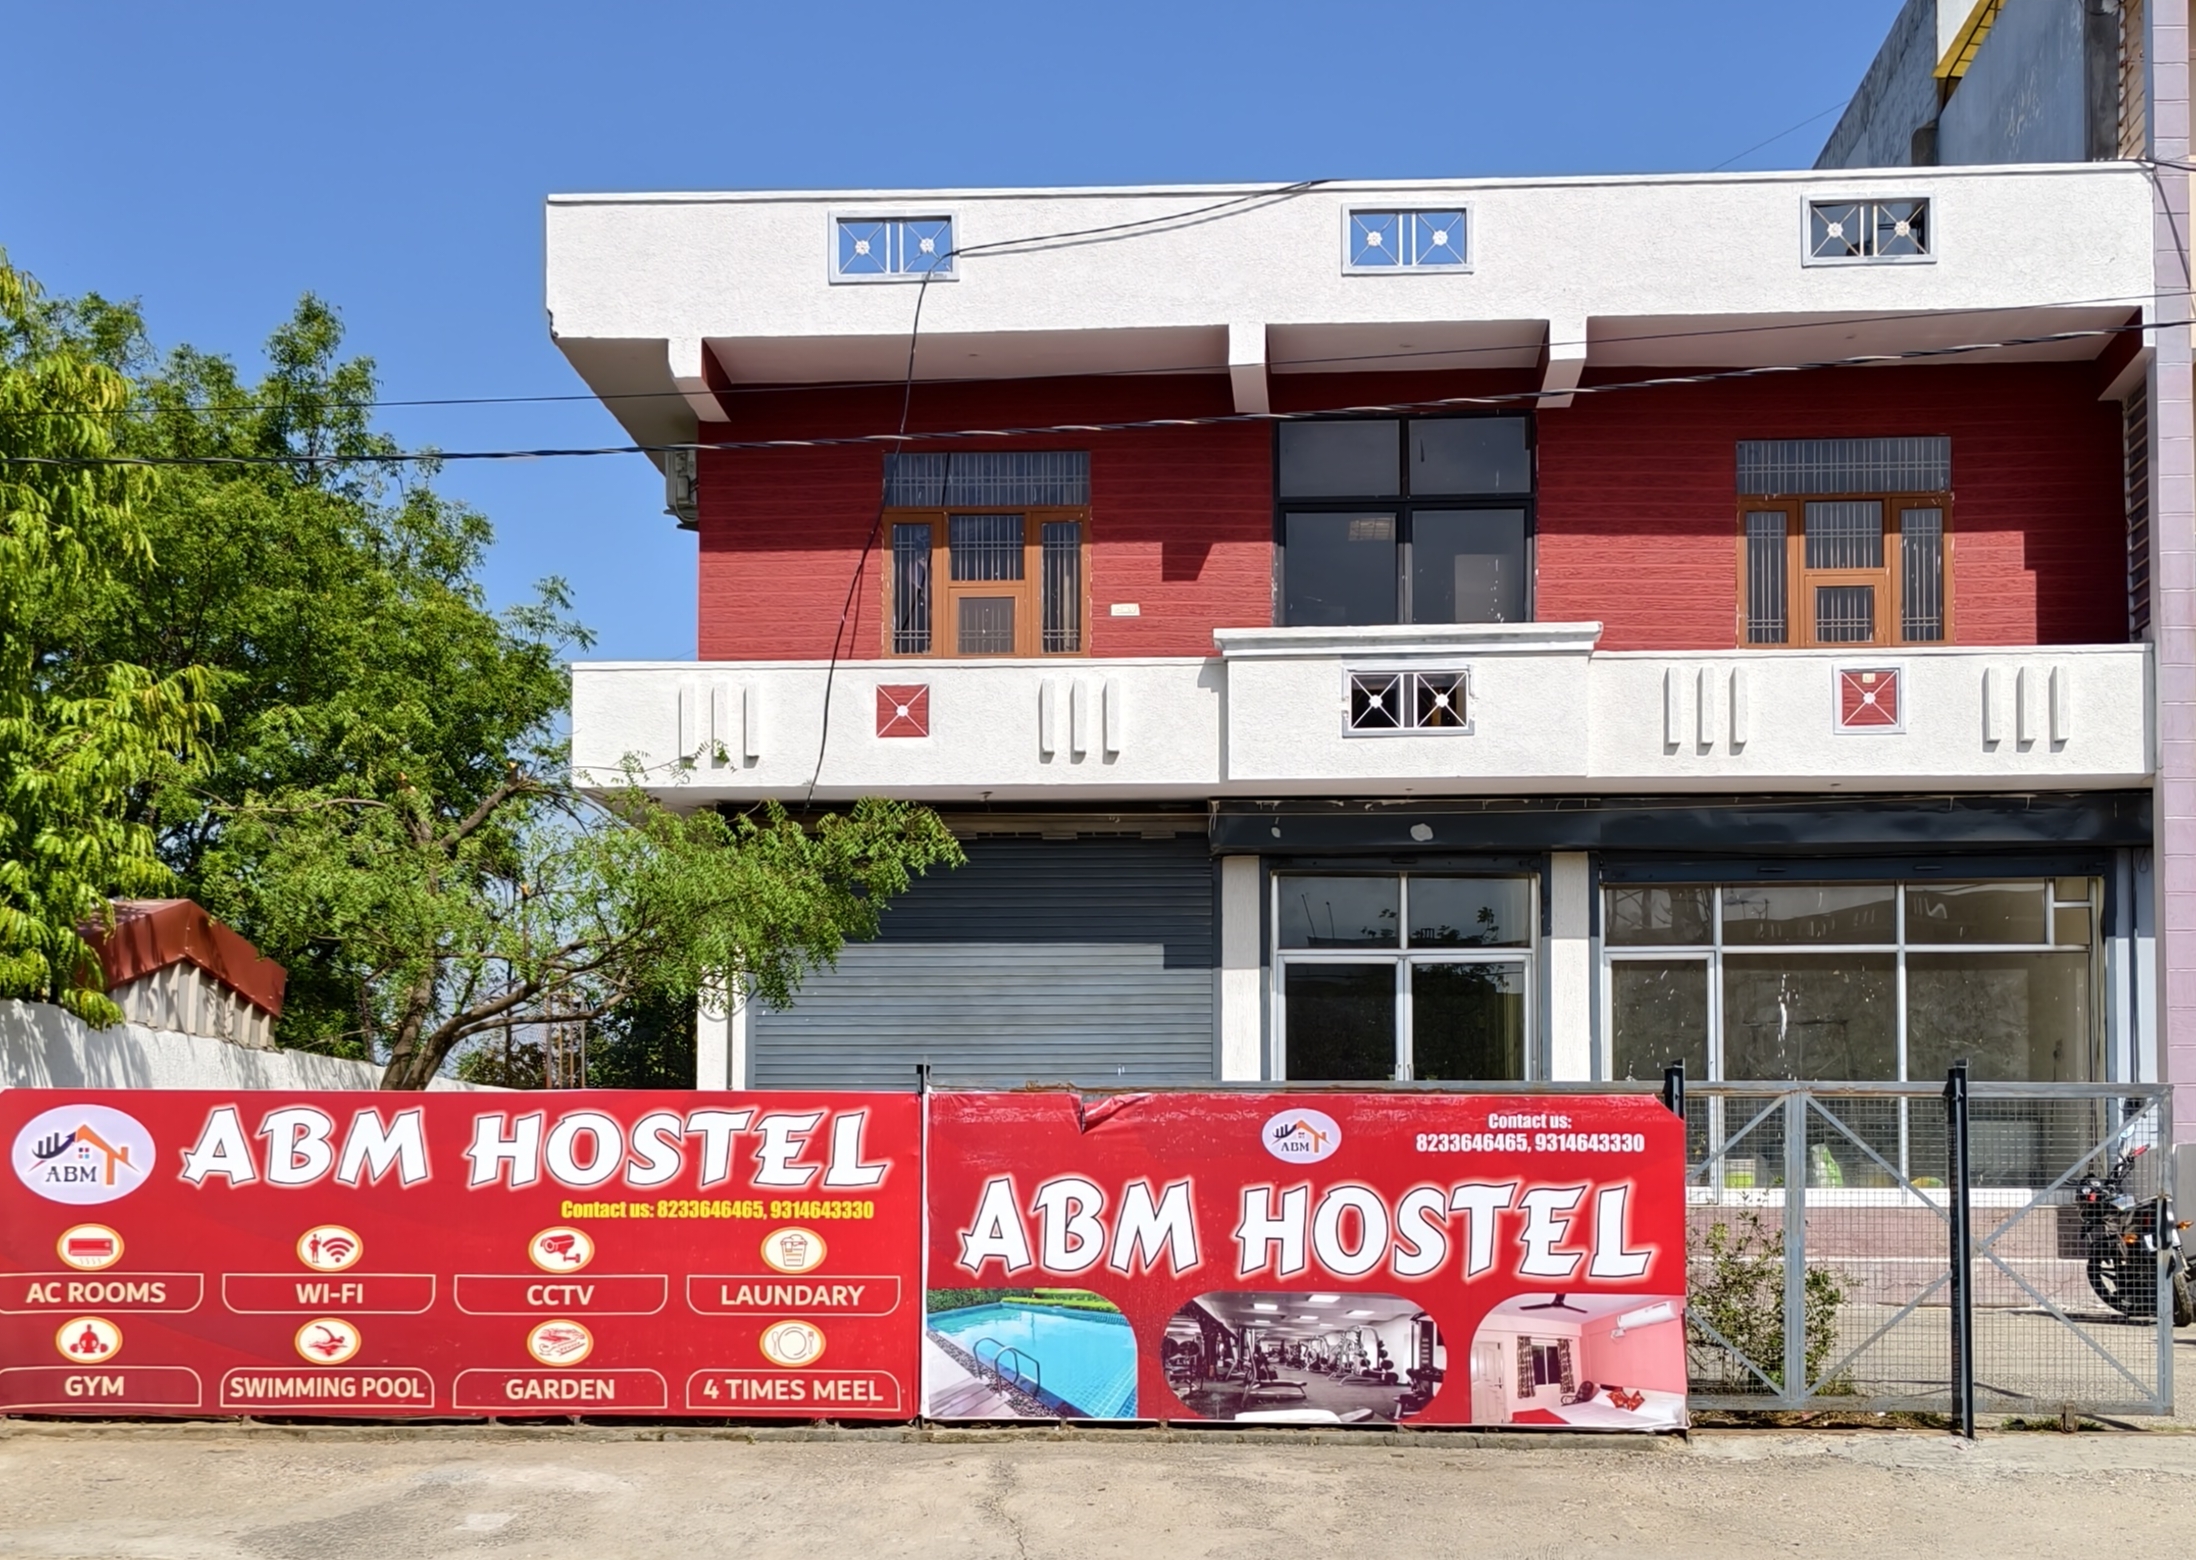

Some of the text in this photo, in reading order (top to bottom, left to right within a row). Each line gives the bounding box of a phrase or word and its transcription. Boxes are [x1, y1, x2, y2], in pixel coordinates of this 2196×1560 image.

[1488, 1113, 1572, 1131] Contact us:
[182, 1106, 887, 1187] ABM HOSTEL
[1280, 1141, 1310, 1154] ABM
[1416, 1133, 1645, 1154] 8233646465, 9314643330
[45, 1165, 97, 1183] ABM
[561, 1200, 874, 1221] Contact us: 8233646465, 9314643330
[960, 1177, 1651, 1278] ABM HOSTEL
[26, 1281, 166, 1304] AC ROOMS
[295, 1282, 364, 1304] WI-FI
[526, 1284, 595, 1306] CCTV
[720, 1284, 865, 1306] LAUNDARY
[64, 1375, 125, 1397] GYM
[229, 1376, 425, 1398] SWIMMING POOL
[505, 1378, 615, 1401] GARDEN
[702, 1378, 884, 1402] 4 TIMES MEEL
